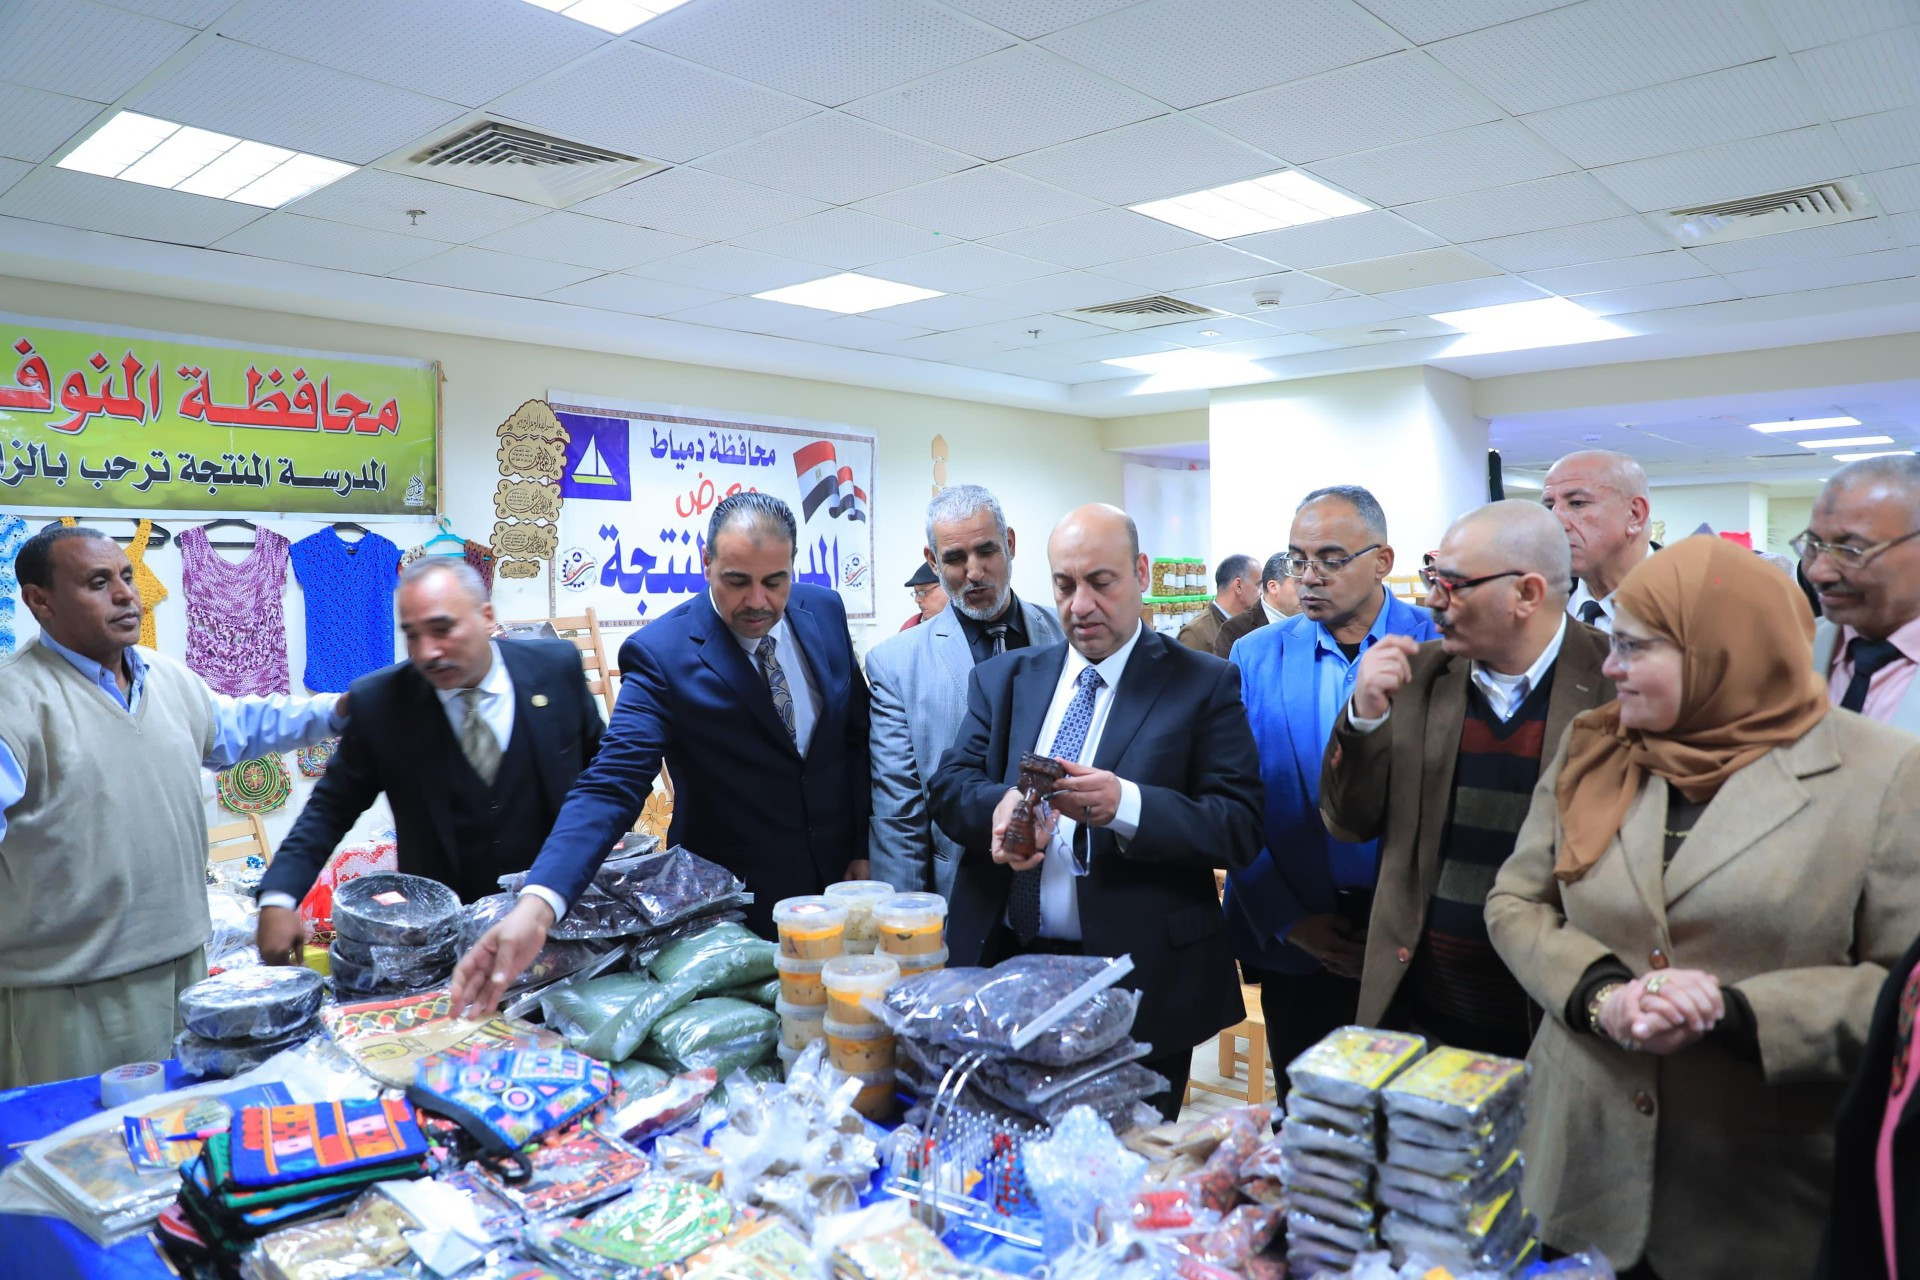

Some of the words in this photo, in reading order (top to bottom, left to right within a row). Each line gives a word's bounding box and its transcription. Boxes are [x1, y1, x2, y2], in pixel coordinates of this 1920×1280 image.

[0, 338, 161, 433] المنوف
[176, 364, 400, 434] محافظة
[0, 438, 69, 488] بالزا
[649, 427, 705, 470] دمياط
[708, 430, 776, 466] محافظة
[79, 450, 172, 492] ترحب
[177, 452, 272, 495] المنتجة
[277, 457, 387, 497] المدرسة
